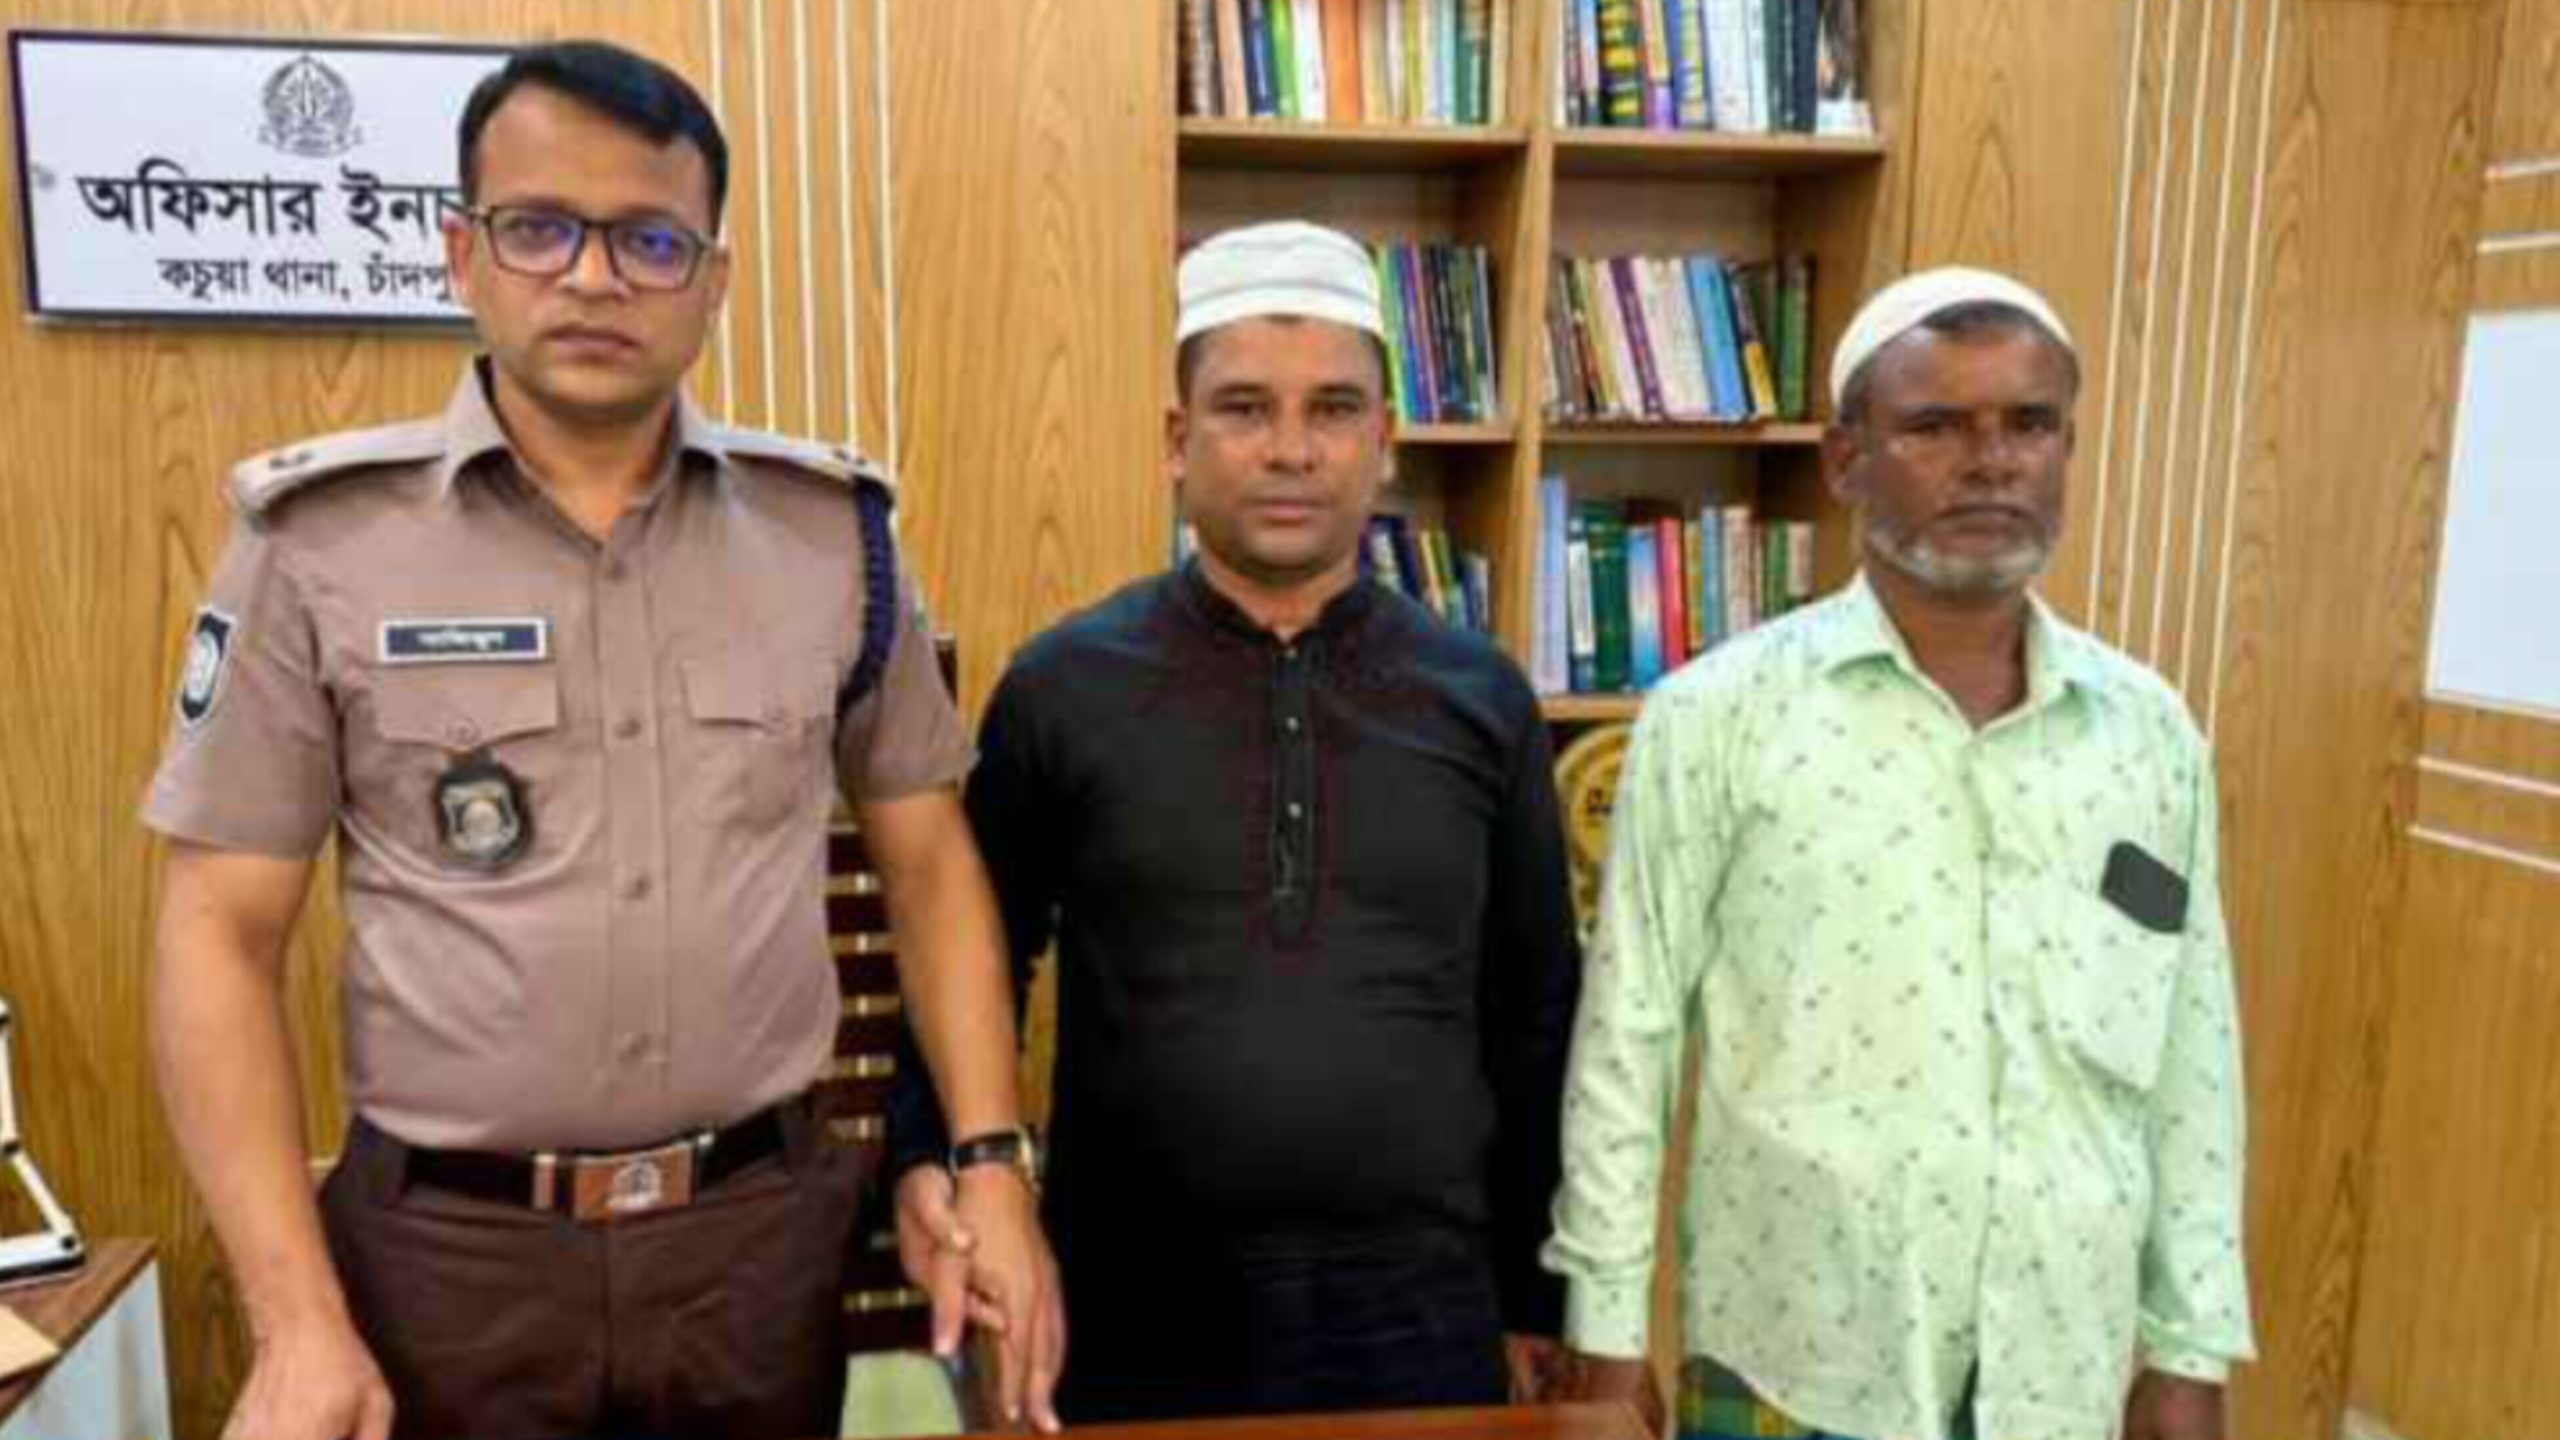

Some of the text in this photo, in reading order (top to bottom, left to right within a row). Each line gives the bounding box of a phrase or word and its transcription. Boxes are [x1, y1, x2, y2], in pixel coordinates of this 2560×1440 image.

[75, 157, 322, 235] অফিসার
[156, 252, 450, 302] কচুয়া থানা, চাঁদপু
